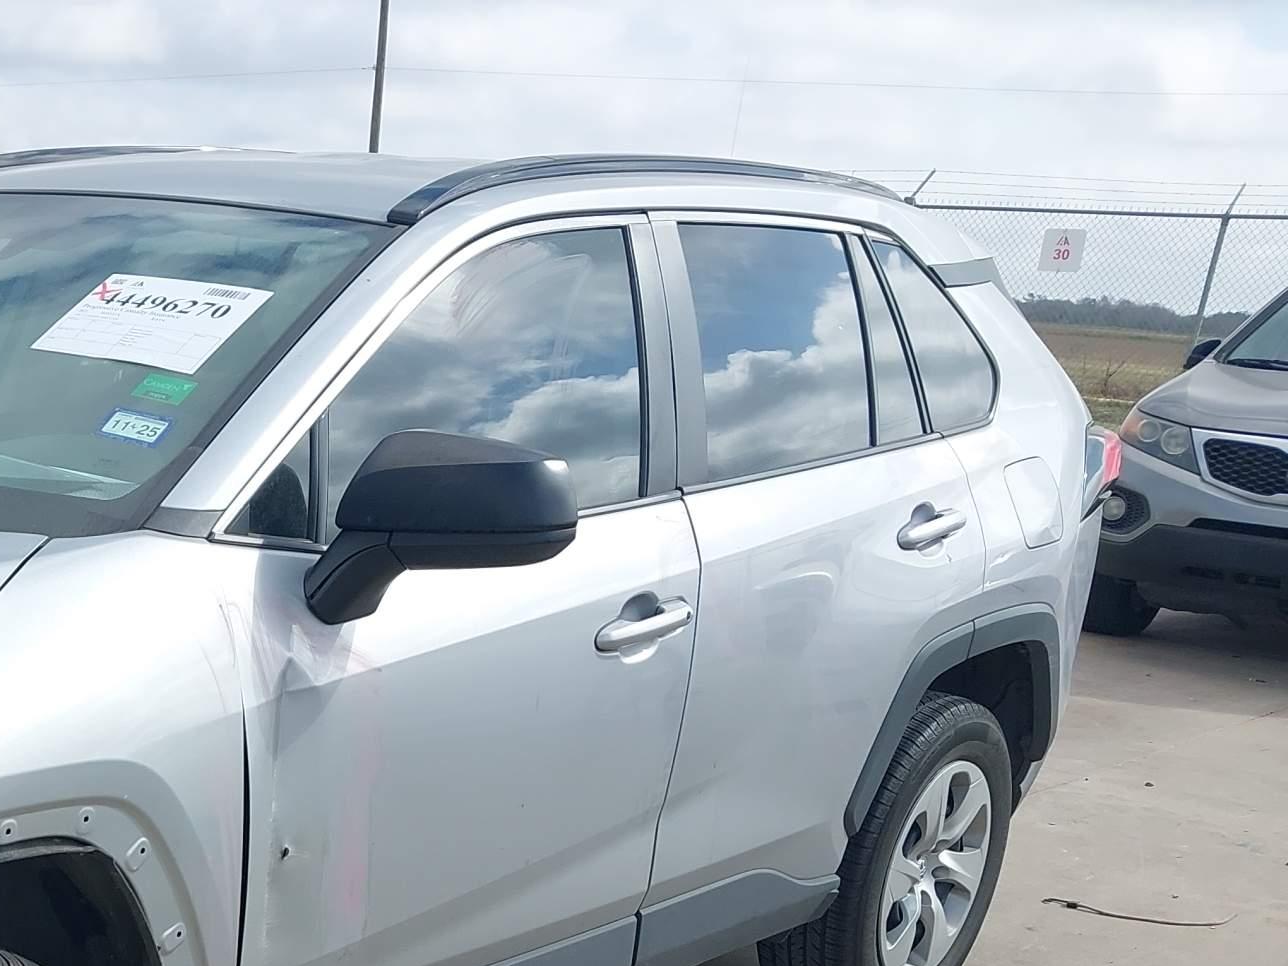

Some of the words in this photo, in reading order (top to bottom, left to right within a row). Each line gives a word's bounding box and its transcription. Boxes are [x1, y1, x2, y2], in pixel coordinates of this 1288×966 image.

[1053, 248, 1070, 260] 30
[102, 291, 232, 319] 44496270
[136, 424, 161, 438] 25
